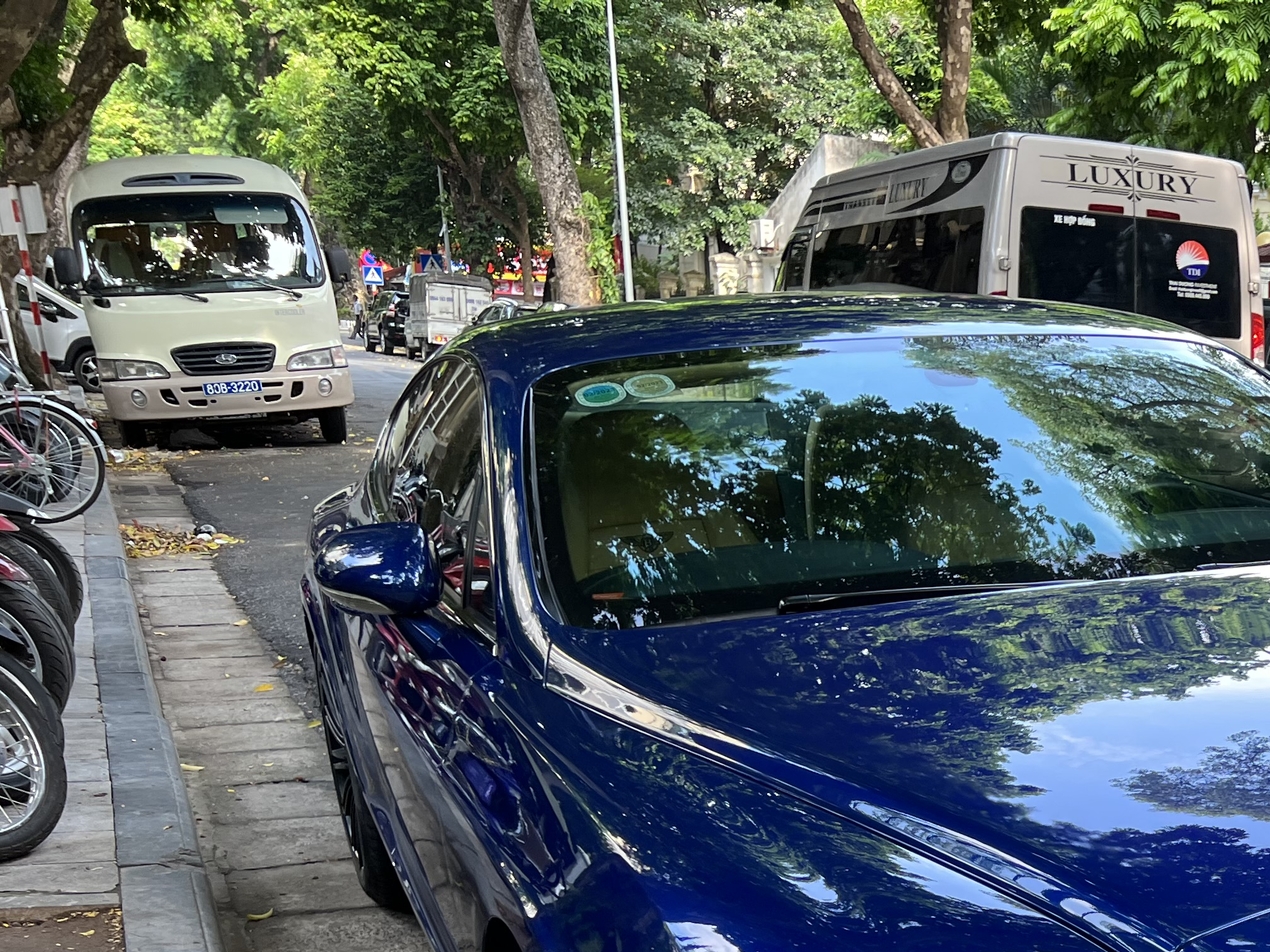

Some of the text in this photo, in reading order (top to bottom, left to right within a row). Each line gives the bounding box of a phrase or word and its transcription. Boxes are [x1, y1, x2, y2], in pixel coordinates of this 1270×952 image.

[1068, 163, 1197, 195] LUXURY
[1186, 267, 1201, 277] TDI
[206, 381, 259, 395] 80B-3220
